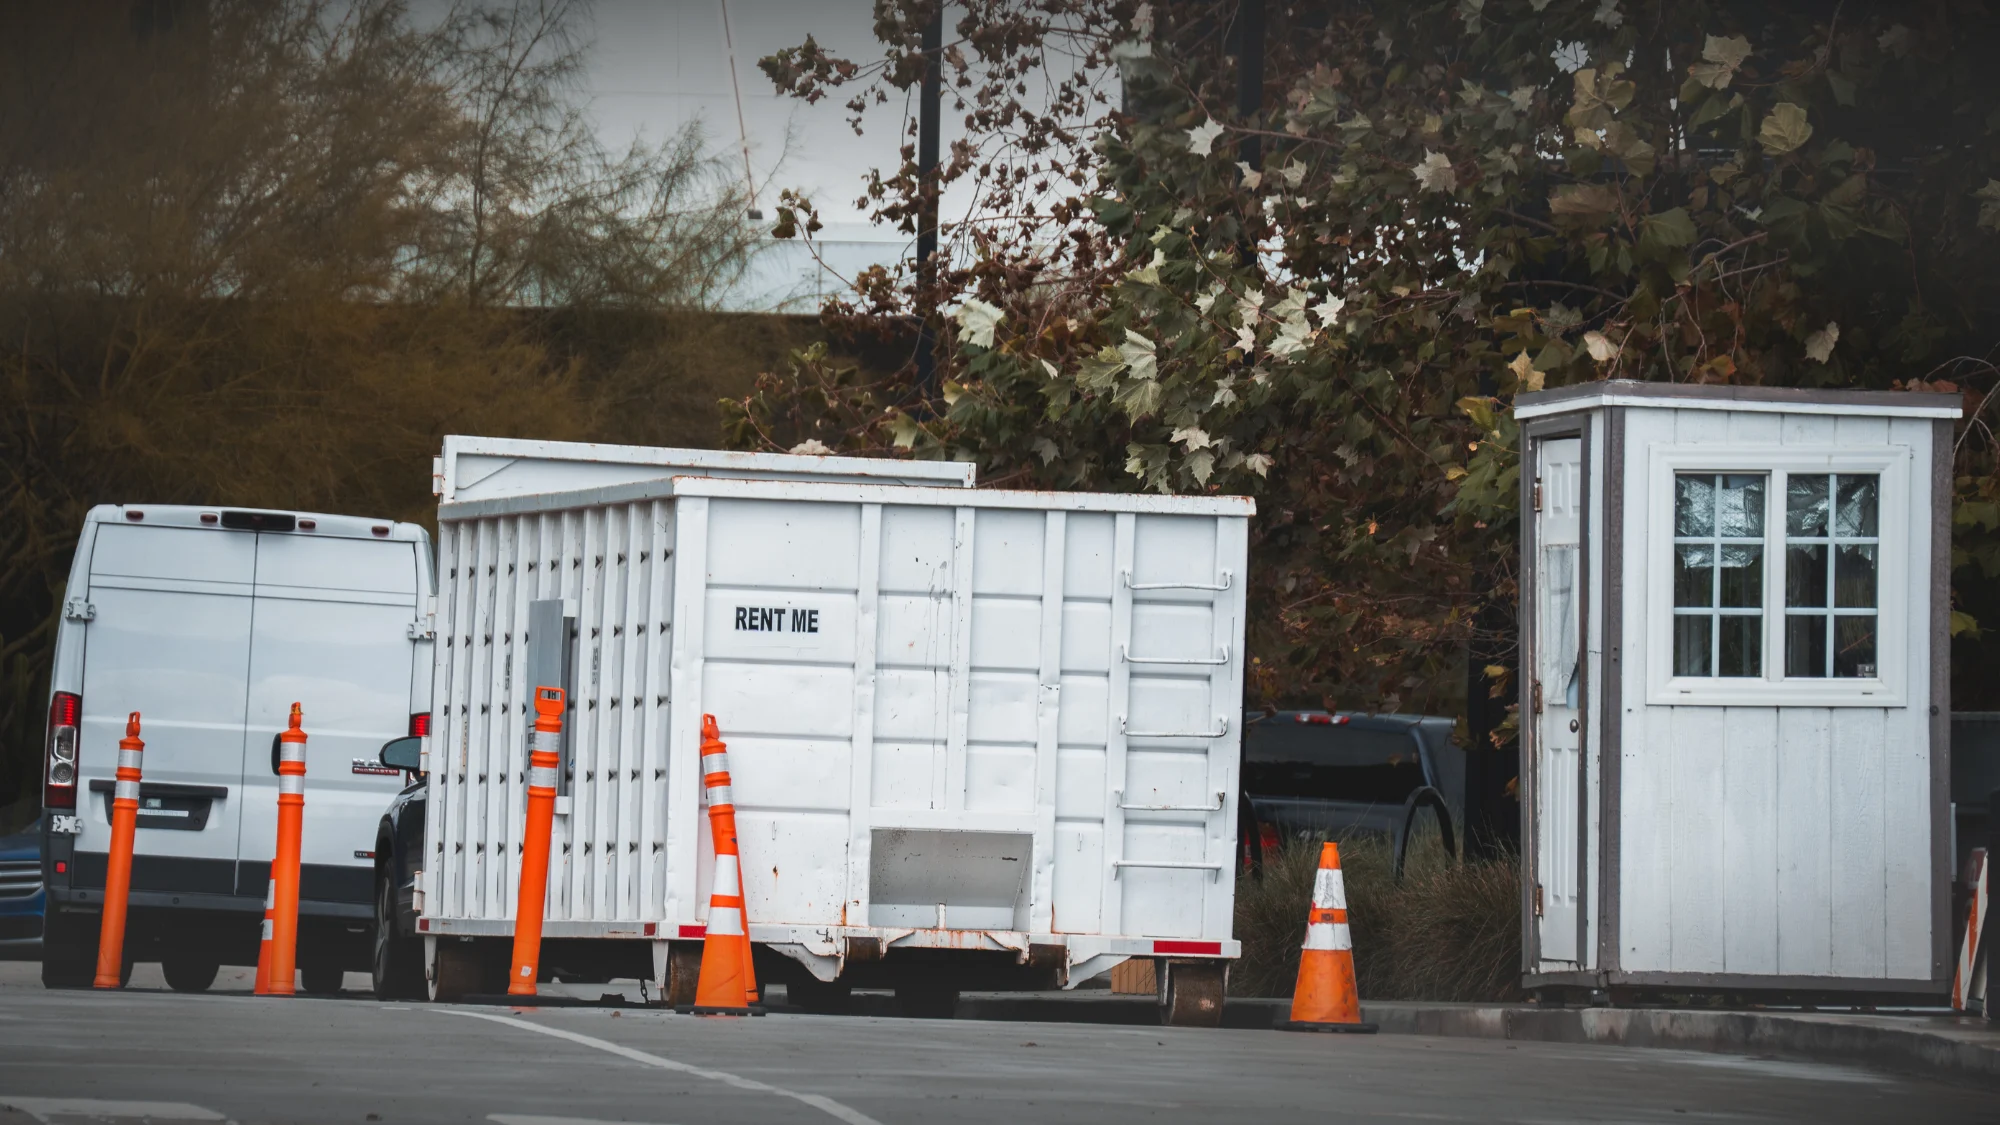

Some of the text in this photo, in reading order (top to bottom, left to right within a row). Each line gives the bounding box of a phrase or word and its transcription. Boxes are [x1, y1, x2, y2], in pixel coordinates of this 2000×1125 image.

[735, 606, 819, 633] RENT ME
[352, 757, 382, 767] RA
